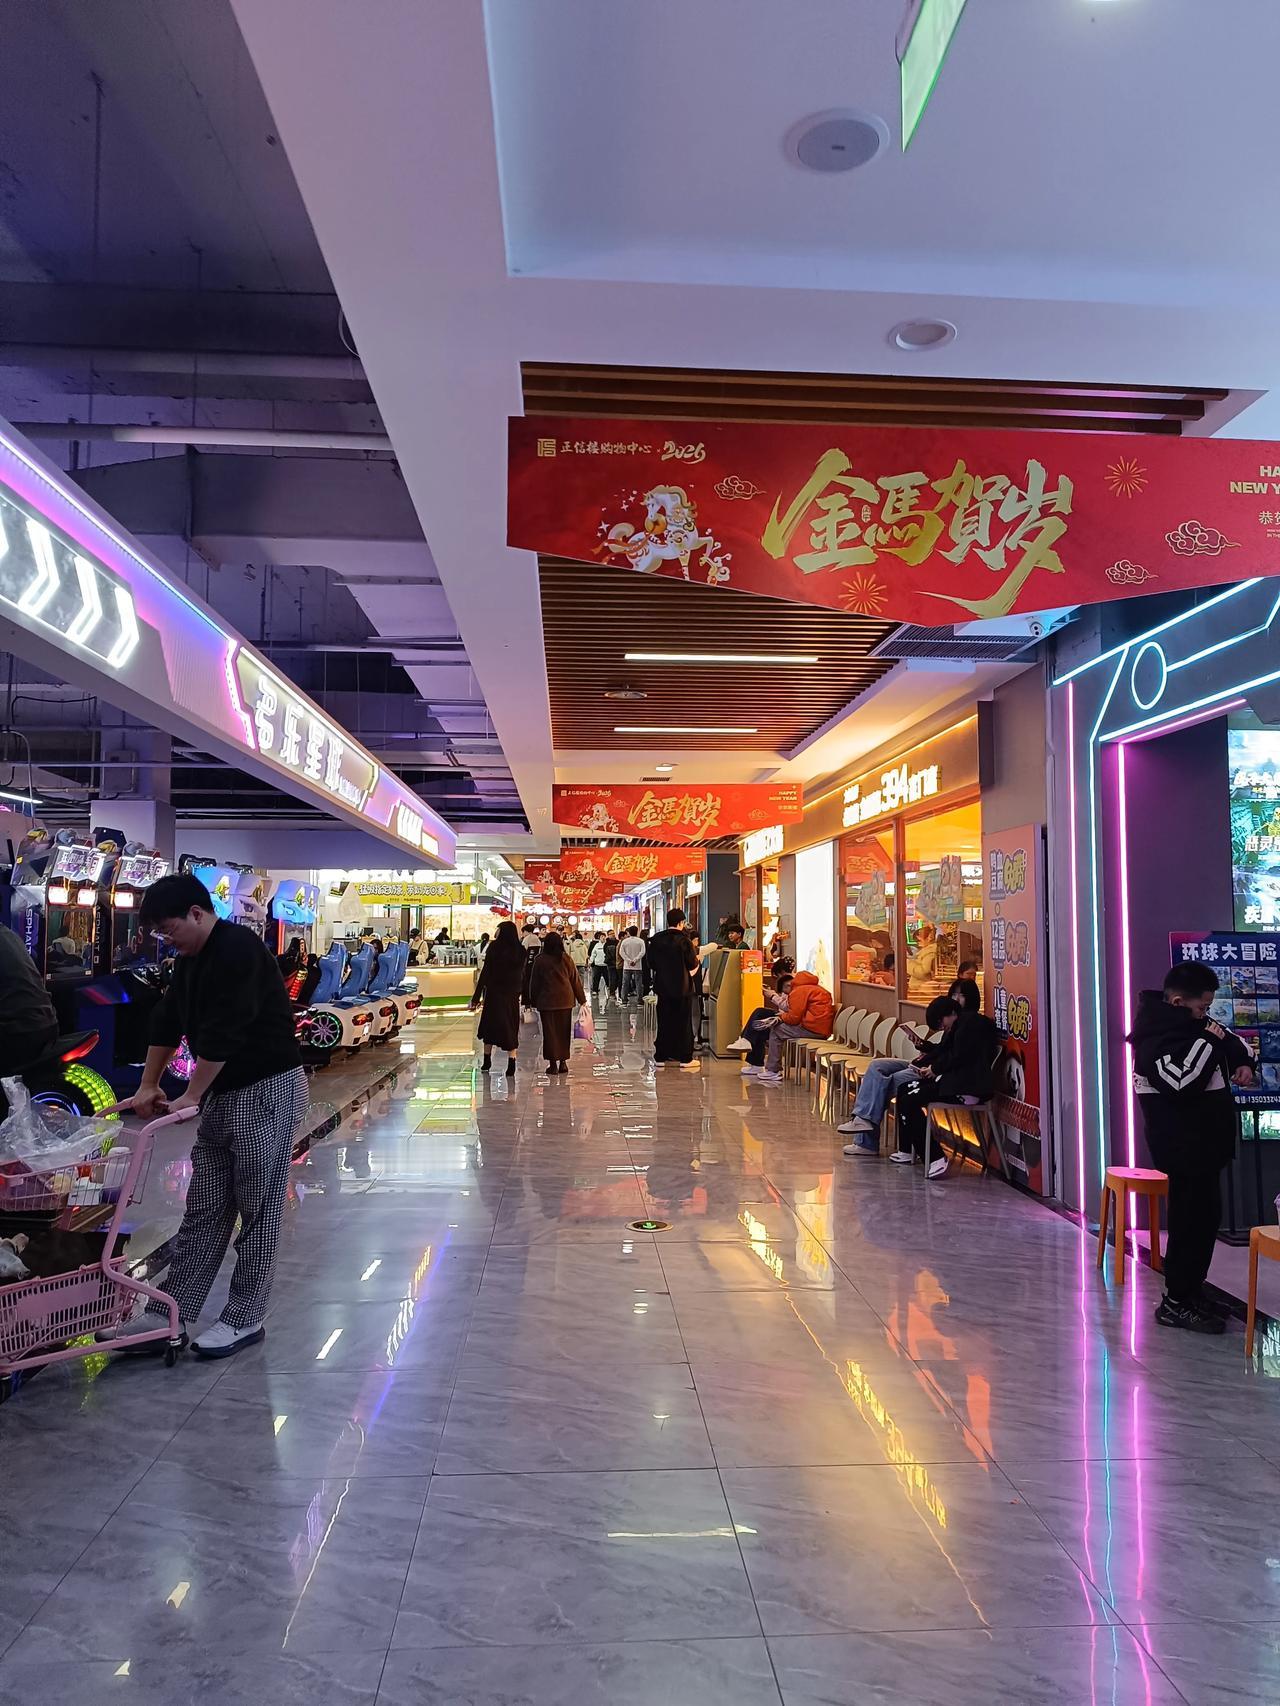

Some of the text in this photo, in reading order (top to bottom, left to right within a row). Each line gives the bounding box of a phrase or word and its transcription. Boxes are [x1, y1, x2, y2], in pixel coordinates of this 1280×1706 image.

[661, 440, 707, 465] 2026
[1230, 481, 1268, 494] NEW
[1181, 942, 1278, 962] 环球大冒险
